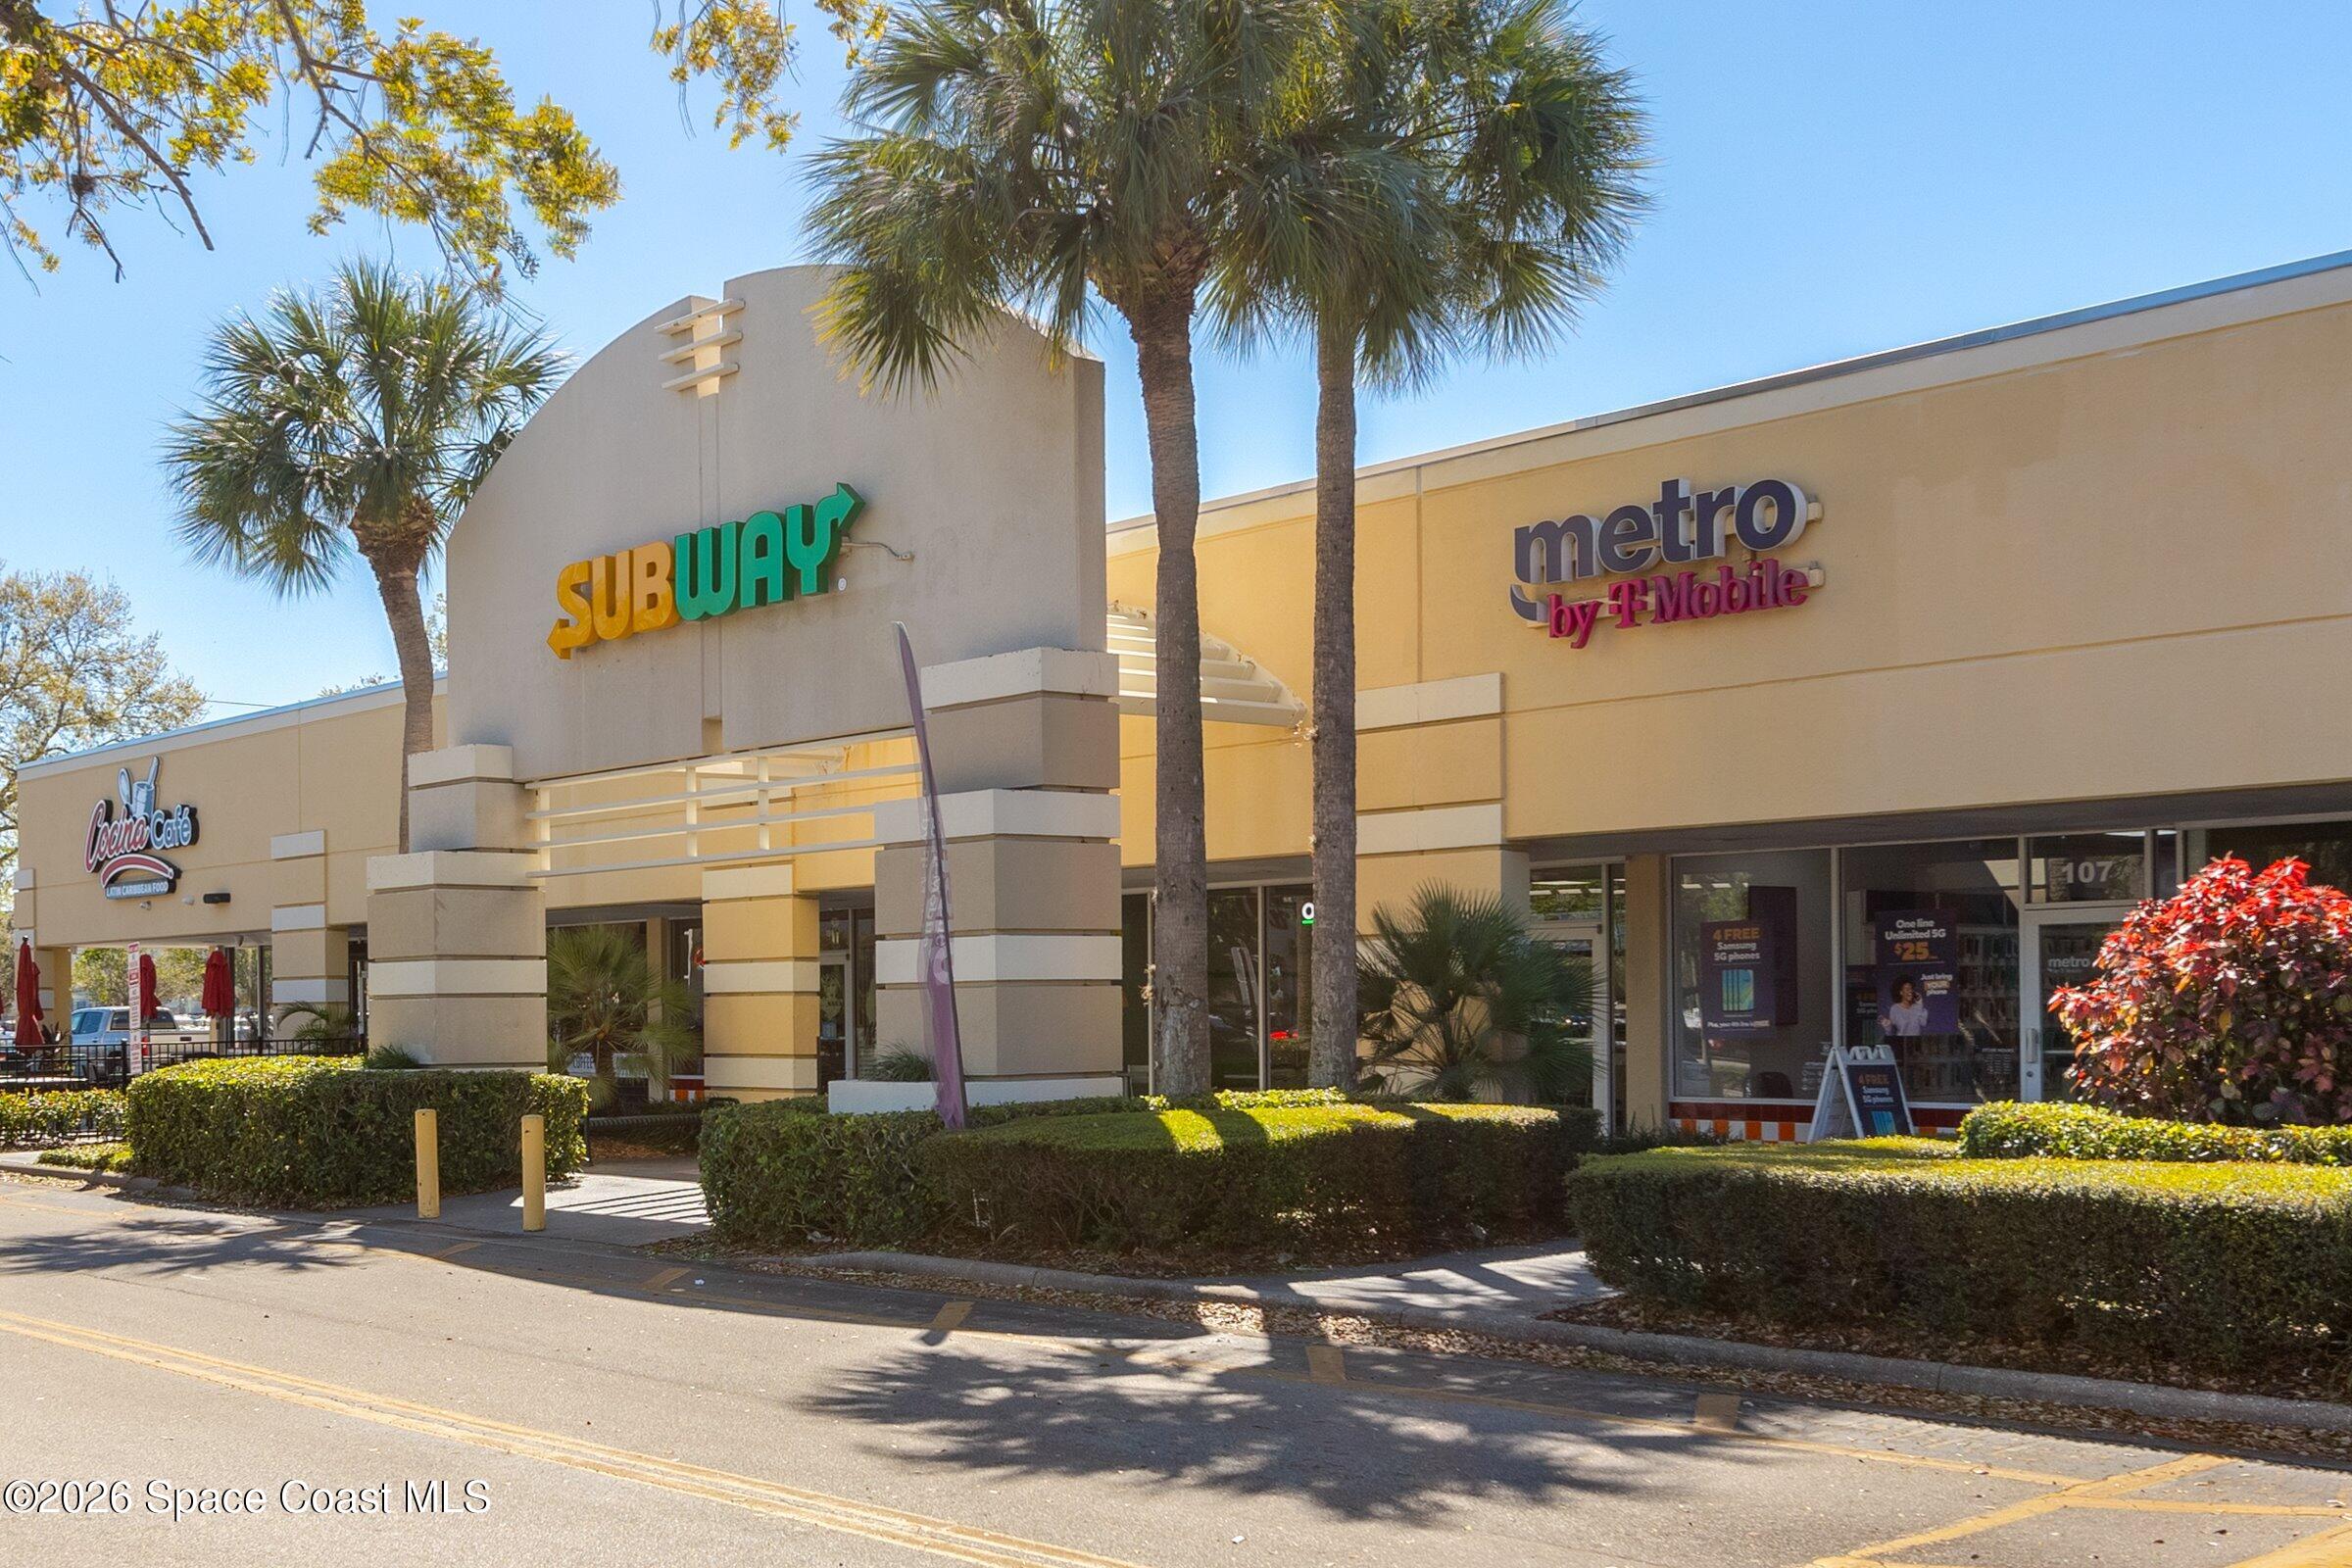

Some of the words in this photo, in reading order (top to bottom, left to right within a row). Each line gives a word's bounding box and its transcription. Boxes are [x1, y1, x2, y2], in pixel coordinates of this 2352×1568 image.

[1514, 478, 1809, 585] metro
[547, 482, 865, 661] SUBWAY
[1546, 593, 1604, 649] by
[85, 799, 150, 873] Cocina
[150, 804, 193, 851] Café
[2061, 861, 2113, 884] 107
[107, 886, 122, 897] LATIN
[122, 883, 152, 896] CARIBBEAN
[152, 881, 169, 894] FOOD
[1895, 919, 1916, 928] One
[1917, 918, 1936, 927] line
[1712, 928, 1722, 941] 4
[1725, 927, 1762, 940] FREE
[1885, 930, 1931, 940] Unlimited
[1932, 929, 1947, 938] 5G
[1717, 942, 1758, 951] Samsung
[1893, 942, 1930, 960] $25
[1728, 952, 1761, 962] phones
[2048, 956, 2090, 968] metro
